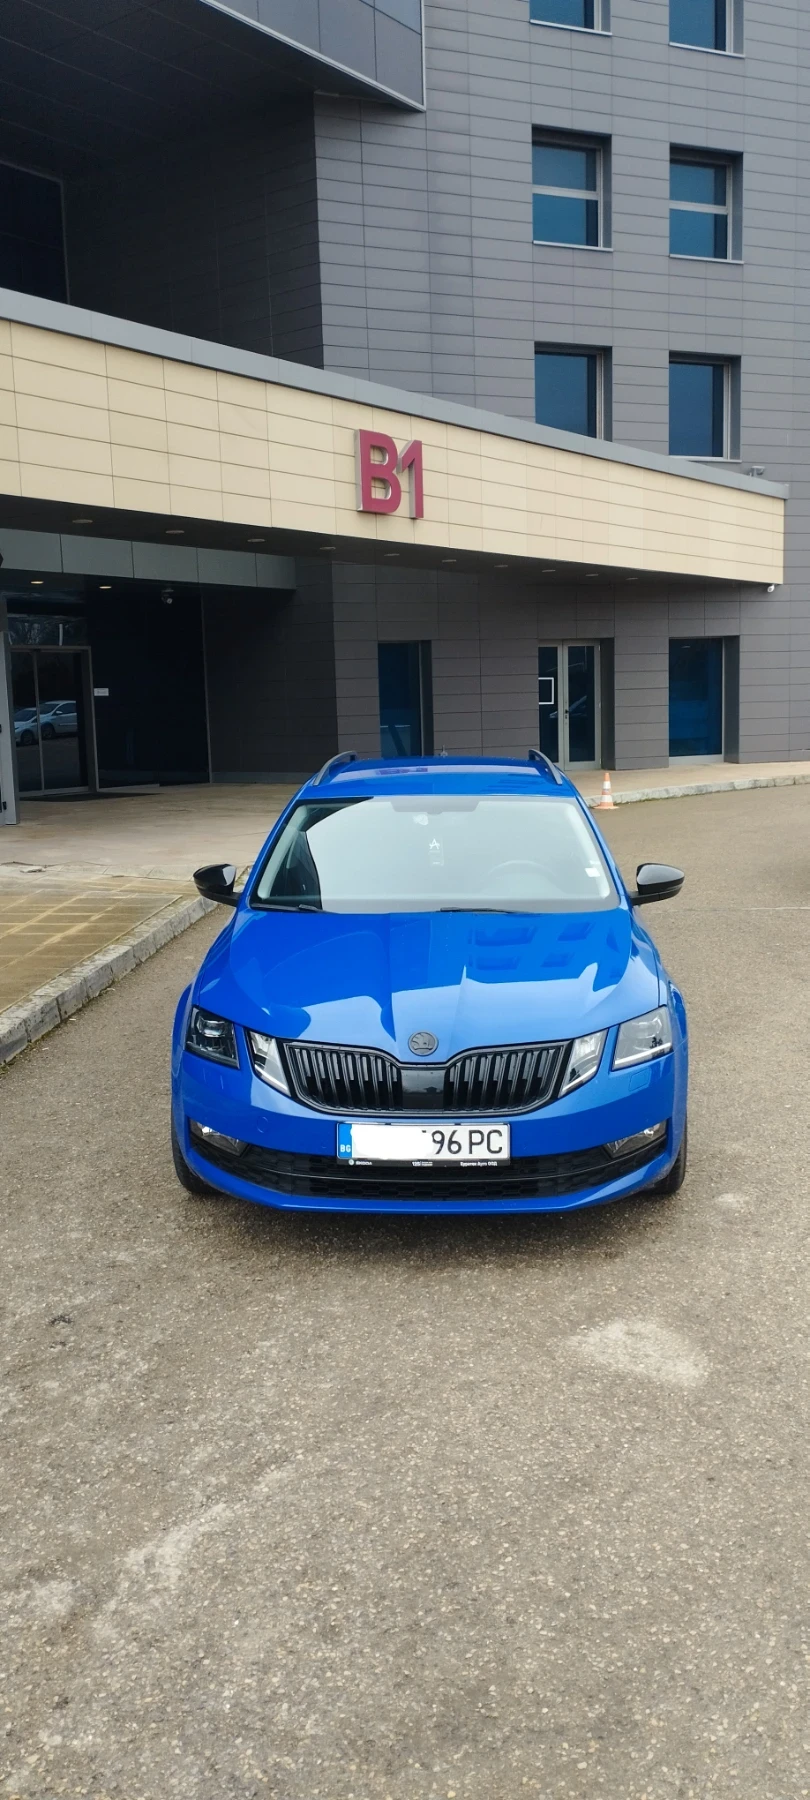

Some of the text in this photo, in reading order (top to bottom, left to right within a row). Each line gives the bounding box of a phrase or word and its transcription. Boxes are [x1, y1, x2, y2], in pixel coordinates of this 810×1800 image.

[354, 428, 424, 518] B1
[340, 1144, 352, 1153] BG
[421, 1129, 503, 1155] 96 PC
